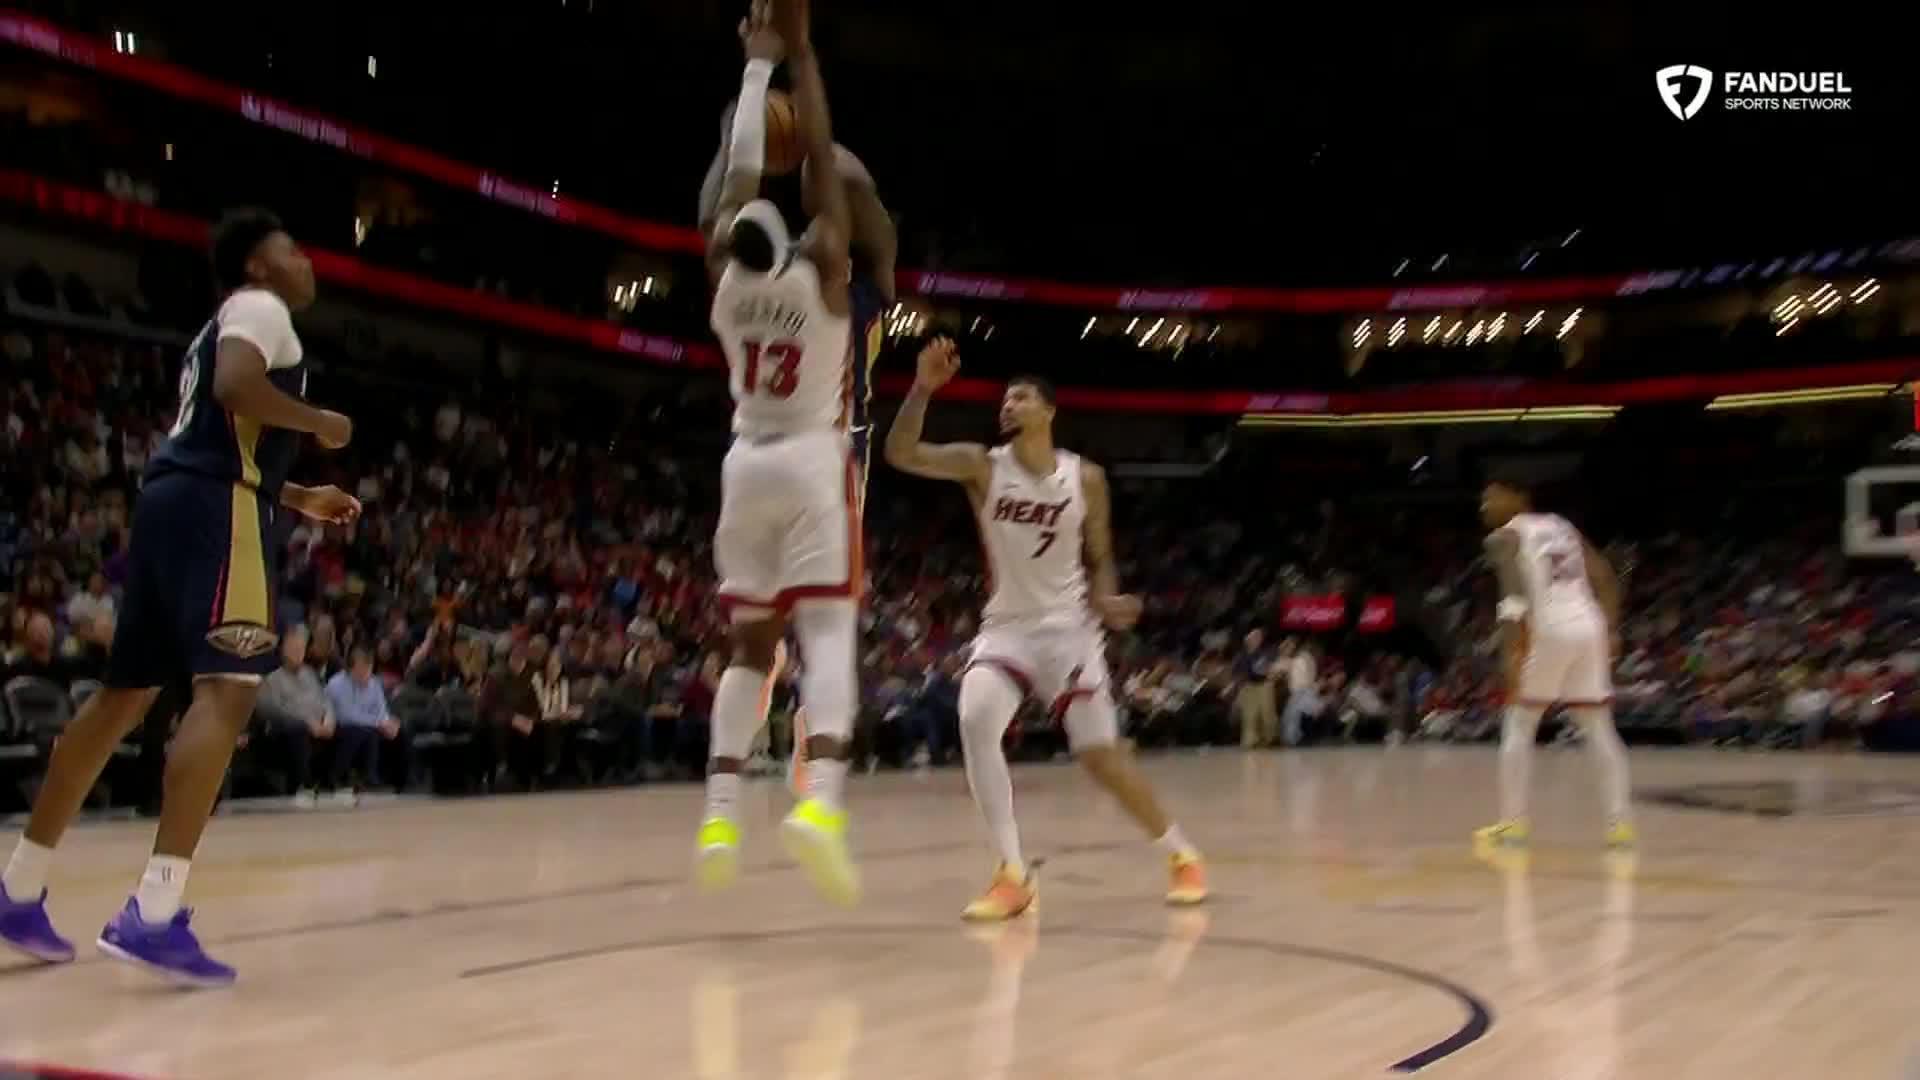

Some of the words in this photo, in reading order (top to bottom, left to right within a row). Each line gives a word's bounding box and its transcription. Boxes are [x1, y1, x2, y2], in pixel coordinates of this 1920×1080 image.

[743, 338, 803, 399] 13
[992, 496, 1072, 528] HEAT
[1031, 531, 1055, 559] 7
